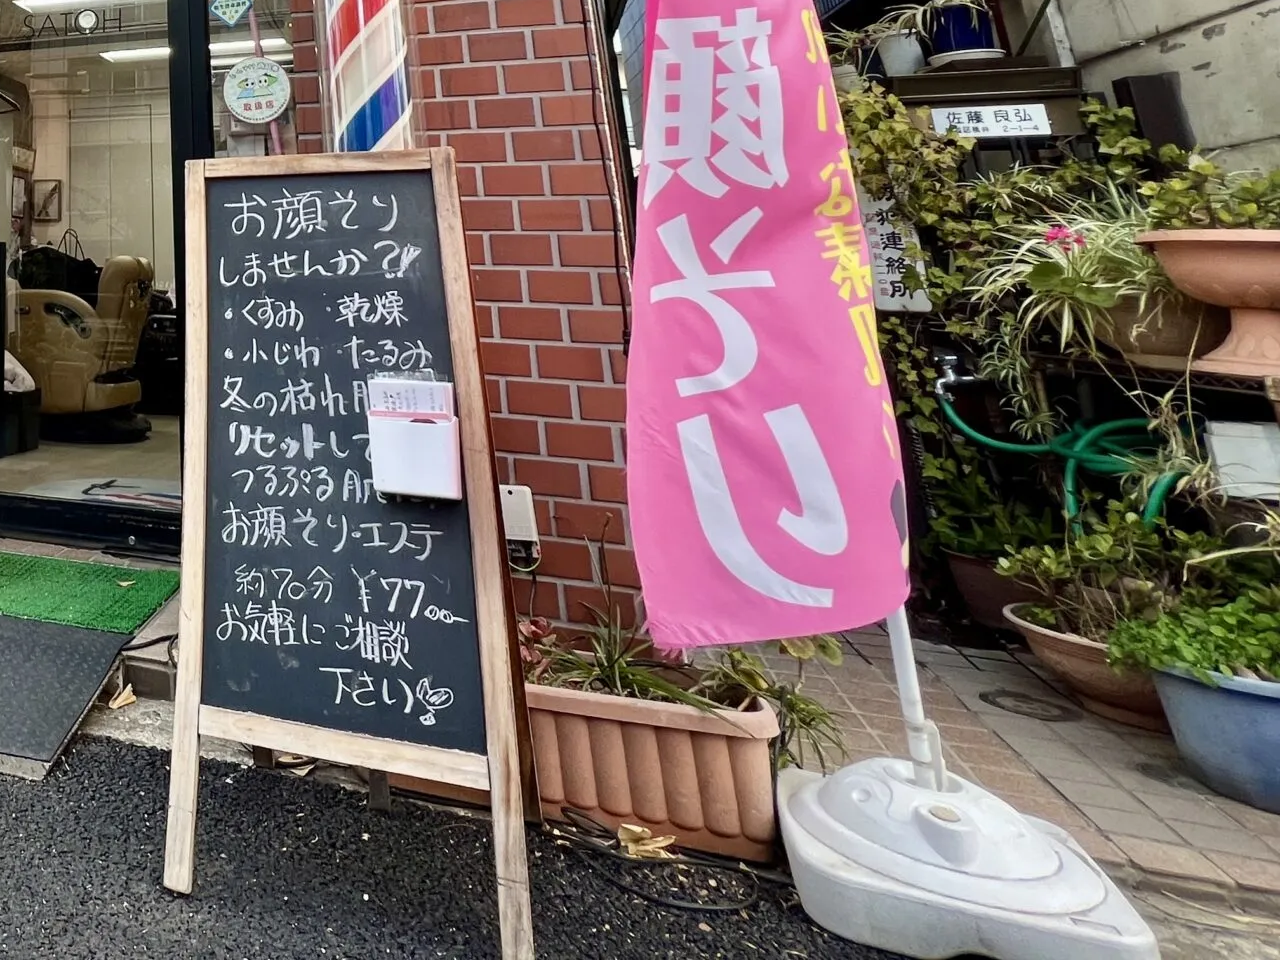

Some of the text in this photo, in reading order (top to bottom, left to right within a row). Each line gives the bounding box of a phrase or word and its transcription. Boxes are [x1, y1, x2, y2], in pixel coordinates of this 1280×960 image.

[23, 7, 123, 38] SATOH
[946, 108, 1033, 124] 佐藤 良弘
[223, 187, 399, 240] お顔そり
[221, 501, 445, 562] お顔そり・エステ
[234, 563, 335, 604] 約70分
[318, 666, 414, 714] 下さい
